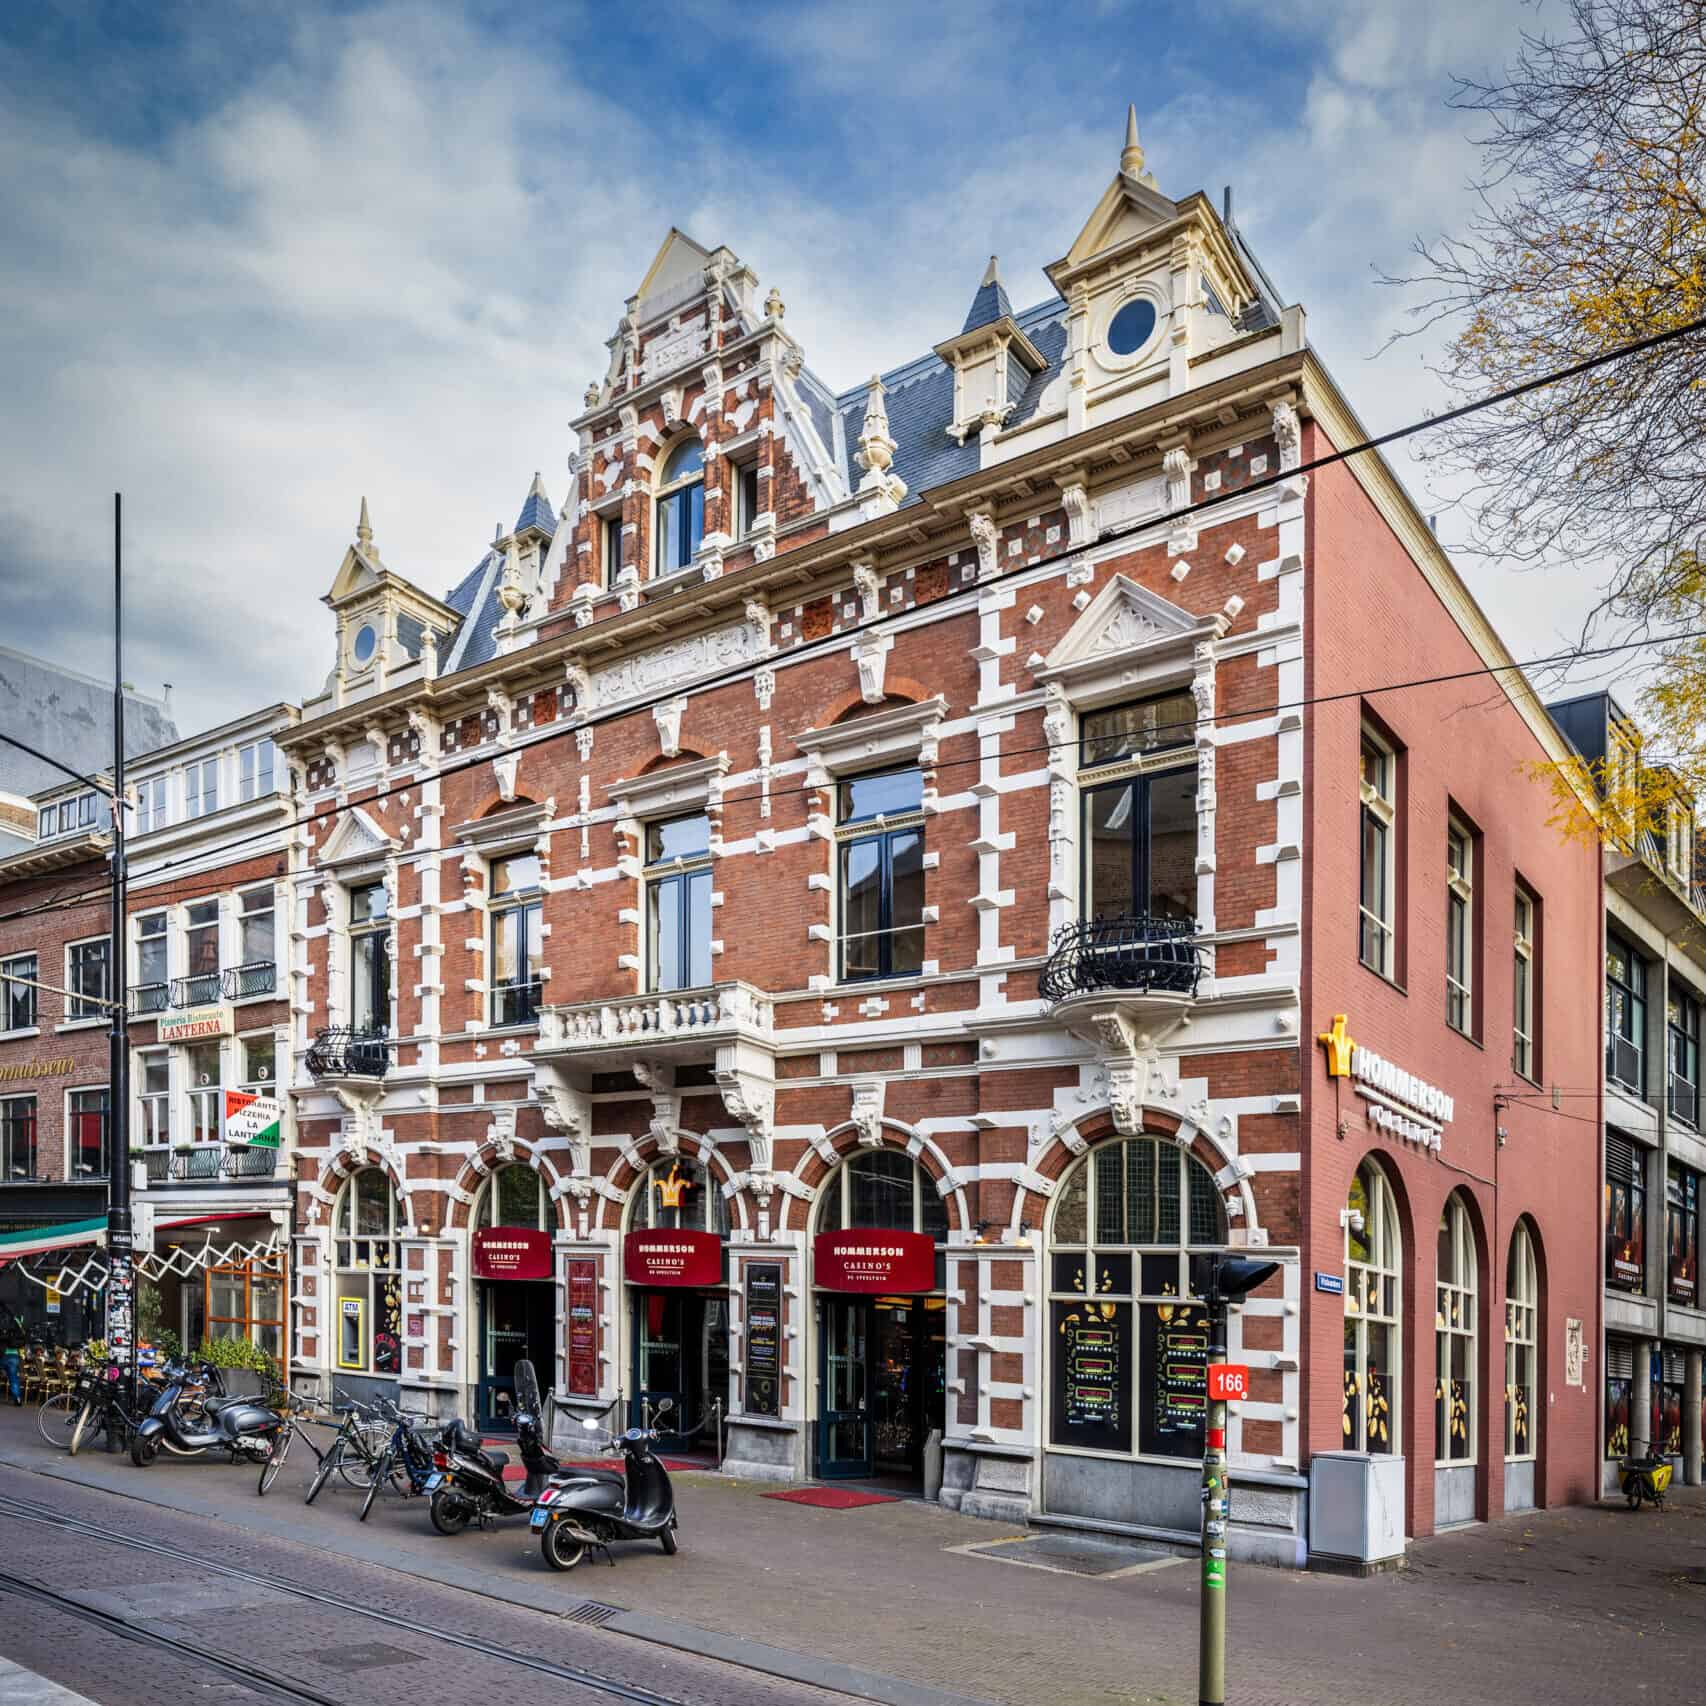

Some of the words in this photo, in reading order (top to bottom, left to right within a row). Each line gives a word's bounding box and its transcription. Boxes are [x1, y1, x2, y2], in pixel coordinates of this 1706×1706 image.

[162, 1019, 221, 1040] LANTERNA
[1352, 1045, 1454, 1122] HOMMERSON
[228, 1096, 278, 1111] RISTORANTE
[234, 1108, 271, 1120] PIZZERIA
[247, 1120, 258, 1129] LA
[228, 1129, 276, 1143] LANTERNA
[833, 1246, 904, 1257] HOMMERSON
[646, 1257, 685, 1266] CASINO'S
[843, 1261, 892, 1271] CASINO'S
[344, 1302, 359, 1312] ATM
[1217, 1373, 1244, 1393] 166
